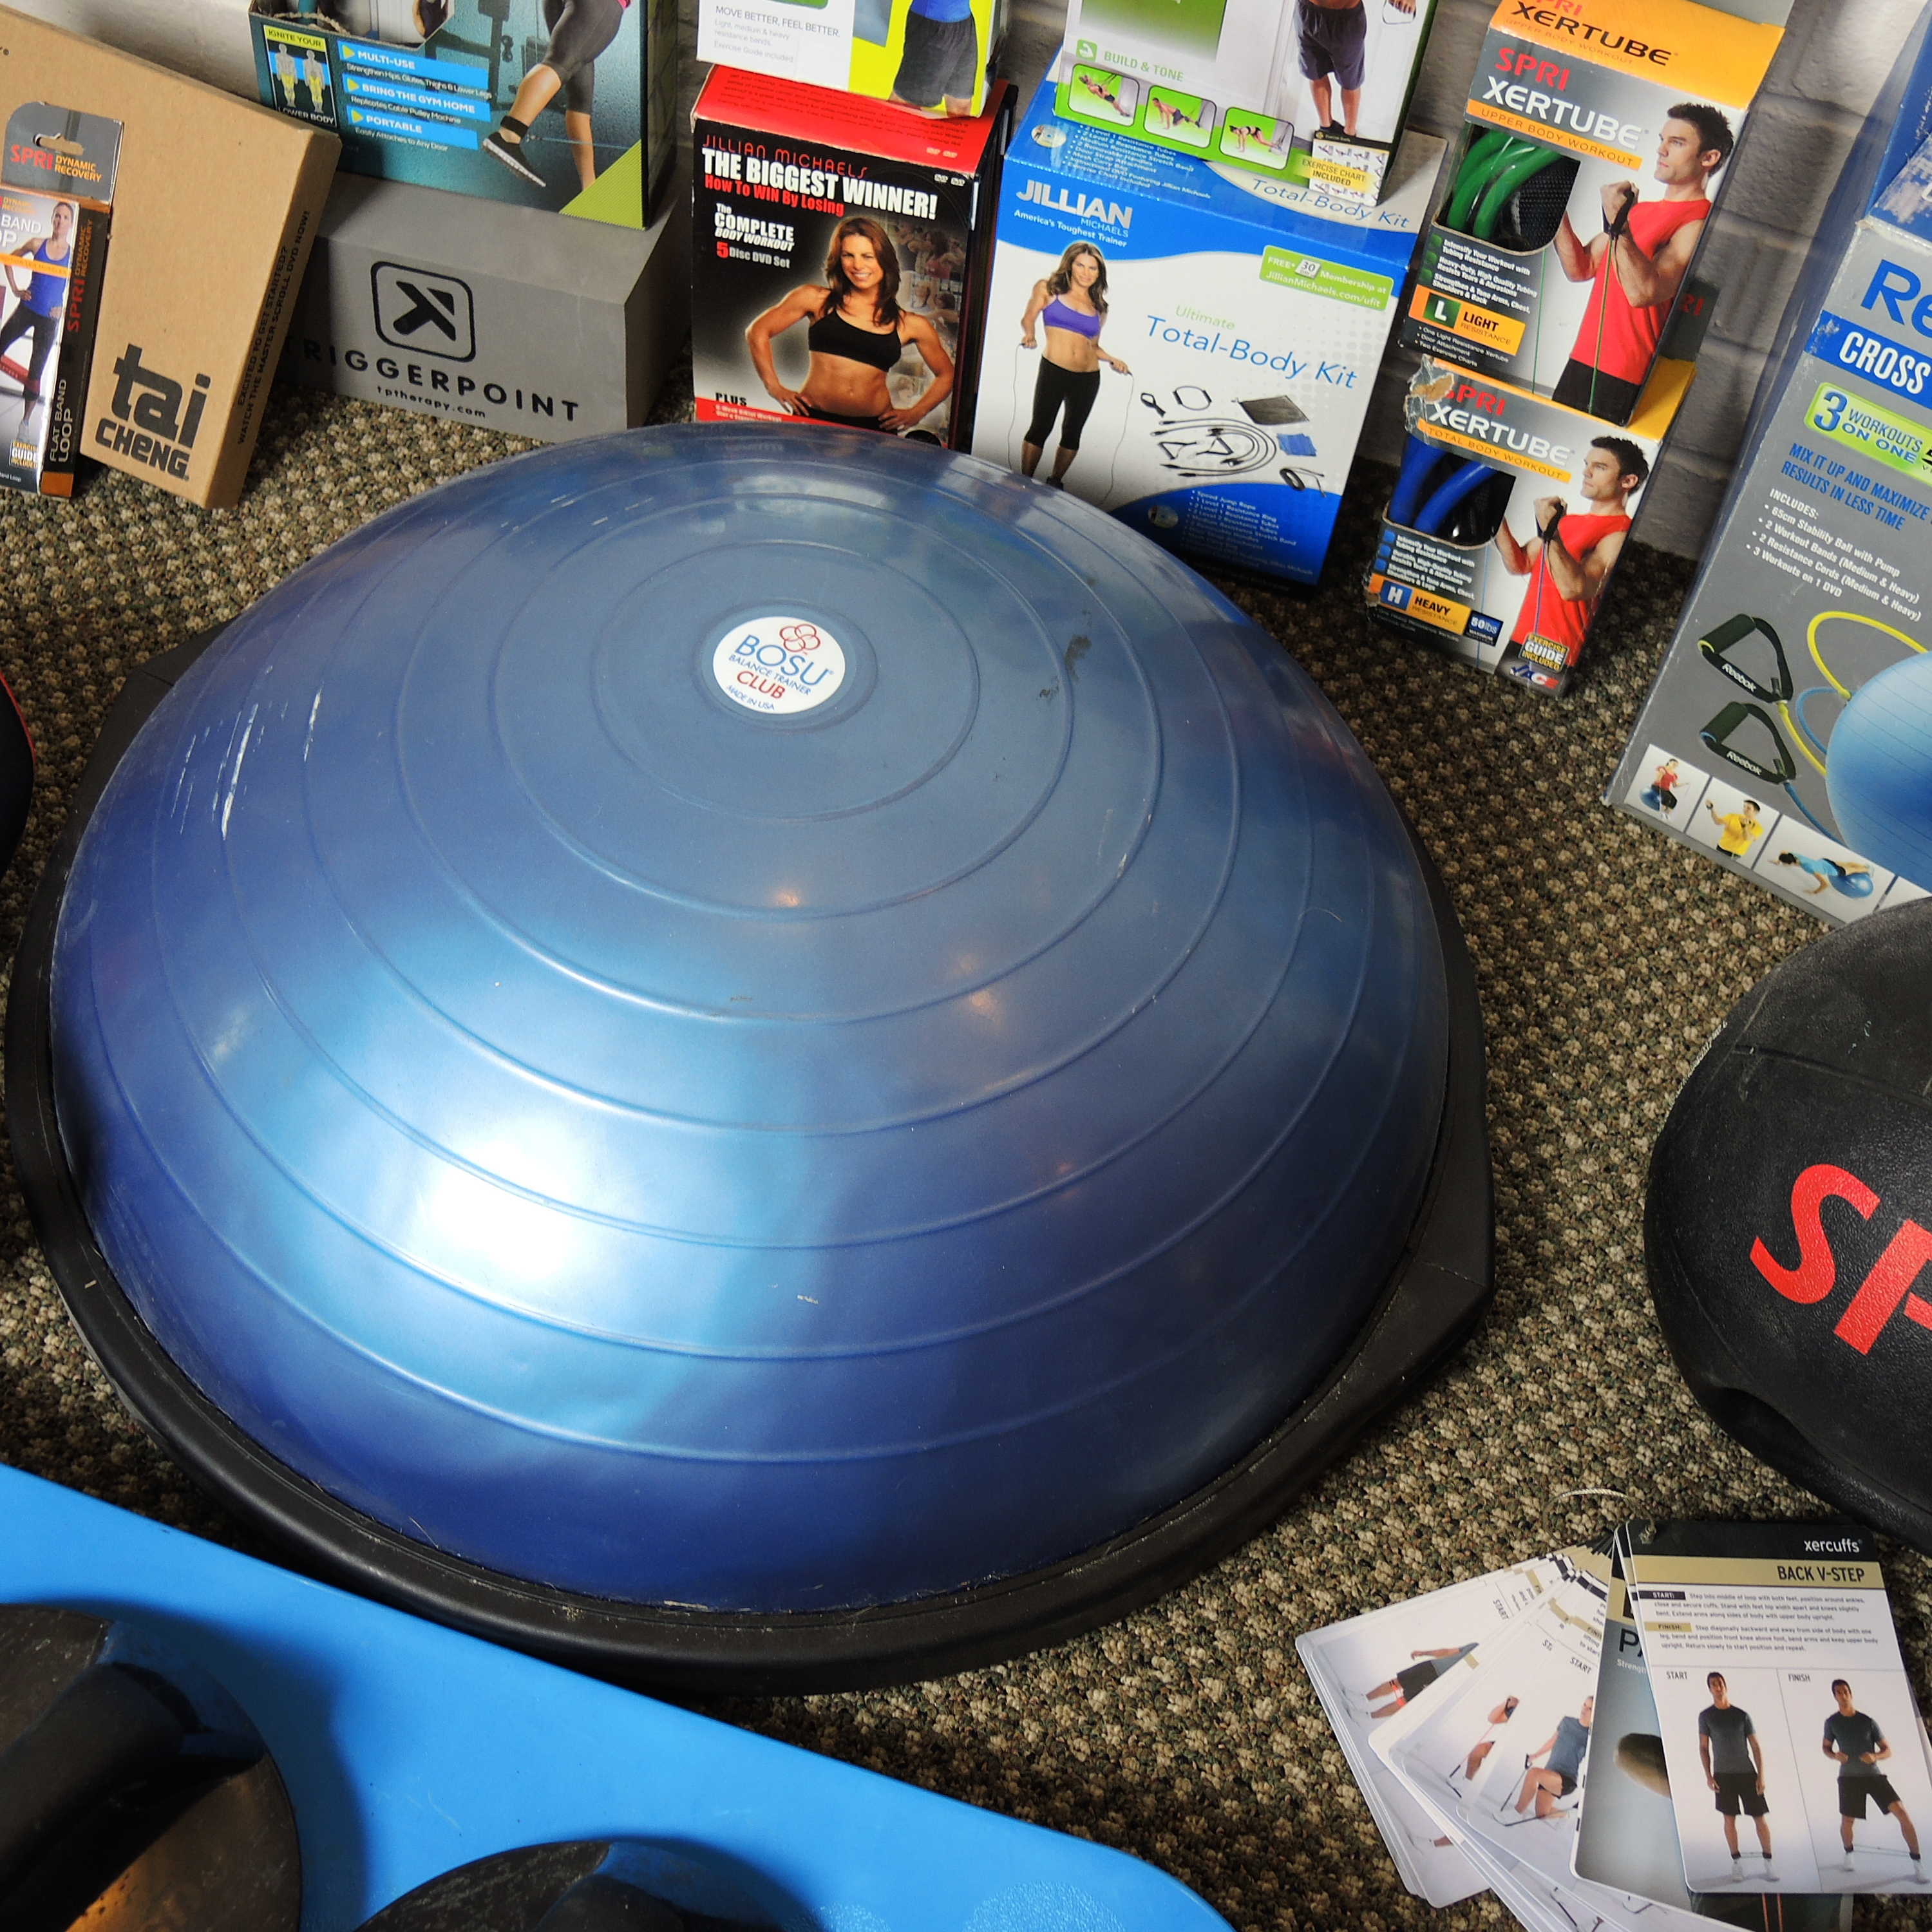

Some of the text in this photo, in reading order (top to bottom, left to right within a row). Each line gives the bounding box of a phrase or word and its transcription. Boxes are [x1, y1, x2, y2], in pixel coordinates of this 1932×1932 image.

[715, 6, 840, 37] MOVE BETTER, FEEL BETTER.
[1511, 1, 1672, 66] XERTUBE
[268, 30, 323, 47] IGNITE YOUR
[357, 50, 415, 70] MULTI-USE
[1104, 51, 1184, 82] BUILD & TONE
[1495, 47, 1570, 91] SPRI
[362, 83, 476, 114] BRING THE GYM HOME
[1482, 75, 1643, 151] XERTUBE
[277, 107, 336, 125] LOWER BODY
[366, 115, 422, 134] PORTABLE
[1481, 108, 1634, 166] UPPER BODY WORKOUT
[11, 144, 54, 170] SPRI
[55, 155, 97, 172] DYNAMIC
[703, 134, 868, 179] JILLIAN MICHAELS
[1302, 158, 1366, 182] EXERCISE CHART
[55, 164, 102, 182] RECOVERY
[702, 147, 938, 220] THE BIGGEST WINNER!
[1312, 170, 1351, 187] INCLUDED
[716, 202, 732, 214] The
[782, 189, 799, 208] By
[800, 193, 845, 218] Losing
[1016, 179, 1133, 230] JILLIAN
[1253, 178, 1410, 229] Total-Body Kit
[1, 214, 42, 234] BAND
[714, 211, 795, 242] COMPLETE
[714, 227, 795, 252] BODY WORKOUT
[1014, 209, 1128, 248] America's Toughest Trainer
[1080, 217, 1129, 238] MICHAELS
[716, 241, 791, 269] 5 Disc DVD Set
[1443, 245, 1500, 272] Tubing Resistance
[1444, 239, 1531, 276] Intensify Your Workout with
[1266, 270, 1381, 308] JillianMichaels.com/ufit
[1301, 261, 1316, 272] 30
[1320, 270, 1376, 292] Membership
[68, 279, 85, 333] SPRI
[1175, 305, 1236, 331] Ultimate
[1434, 299, 1447, 322] L
[1463, 311, 1499, 332] LIGHT
[253, 338, 262, 355] TO
[258, 311, 270, 334] GET
[1460, 323, 1511, 346] RESISTANCE
[1146, 315, 1359, 389] Total-Body Kit
[1839, 330, 1932, 395] CROSS
[111, 343, 211, 450] tai
[377, 385, 486, 419] tptherapy.com
[715, 392, 748, 406] PLUS
[50, 379, 67, 462] FLAT BAND
[58, 408, 73, 463] LOOP
[1429, 402, 1571, 467] XERTUBE
[1814, 390, 1924, 453] 3 WORKOUTS
[1428, 427, 1563, 479] TOTAL BODY WORKOUT
[1841, 422, 1918, 464] ON ONE
[1781, 460, 1906, 531] RESULTS IN LESS TIME
[1789, 442, 1931, 521] MIX IT UP AND MAXIMIZE
[1769, 488, 1819, 520] INCLUDES:
[1772, 506, 1901, 578] 65cm Stability Ball with Pump
[1753, 546, 1842, 598] 3 Workouts on 1 DVD
[1759, 533, 1922, 622] 2 Resistance Cords (Medium & Heavy)
[1765, 519, 1920, 605] 2 Workout Bands (Medium & Heavy)
[1387, 585, 1404, 605] H
[1414, 596, 1451, 616] HEAVY
[1524, 640, 1565, 665] GUIDE
[1528, 633, 1567, 654] EXERCISE
[728, 654, 811, 696] BALANCE TRAINER
[735, 634, 830, 686] BOSU
[1521, 649, 1561, 672] INCLUDED
[736, 670, 786, 699] CLUB
[1721, 663, 1757, 693] Reebok
[726, 684, 775, 712] MADE IN USA
[1727, 750, 1762, 775] Reebok
[1803, 1538, 1860, 1555] xercuffs
[1777, 1565, 1865, 1583] BACK V-STEP
[1492, 1599, 1510, 1620] START
[1569, 1656, 1593, 1674] START
[1665, 1671, 1811, 1683] START FINISH
